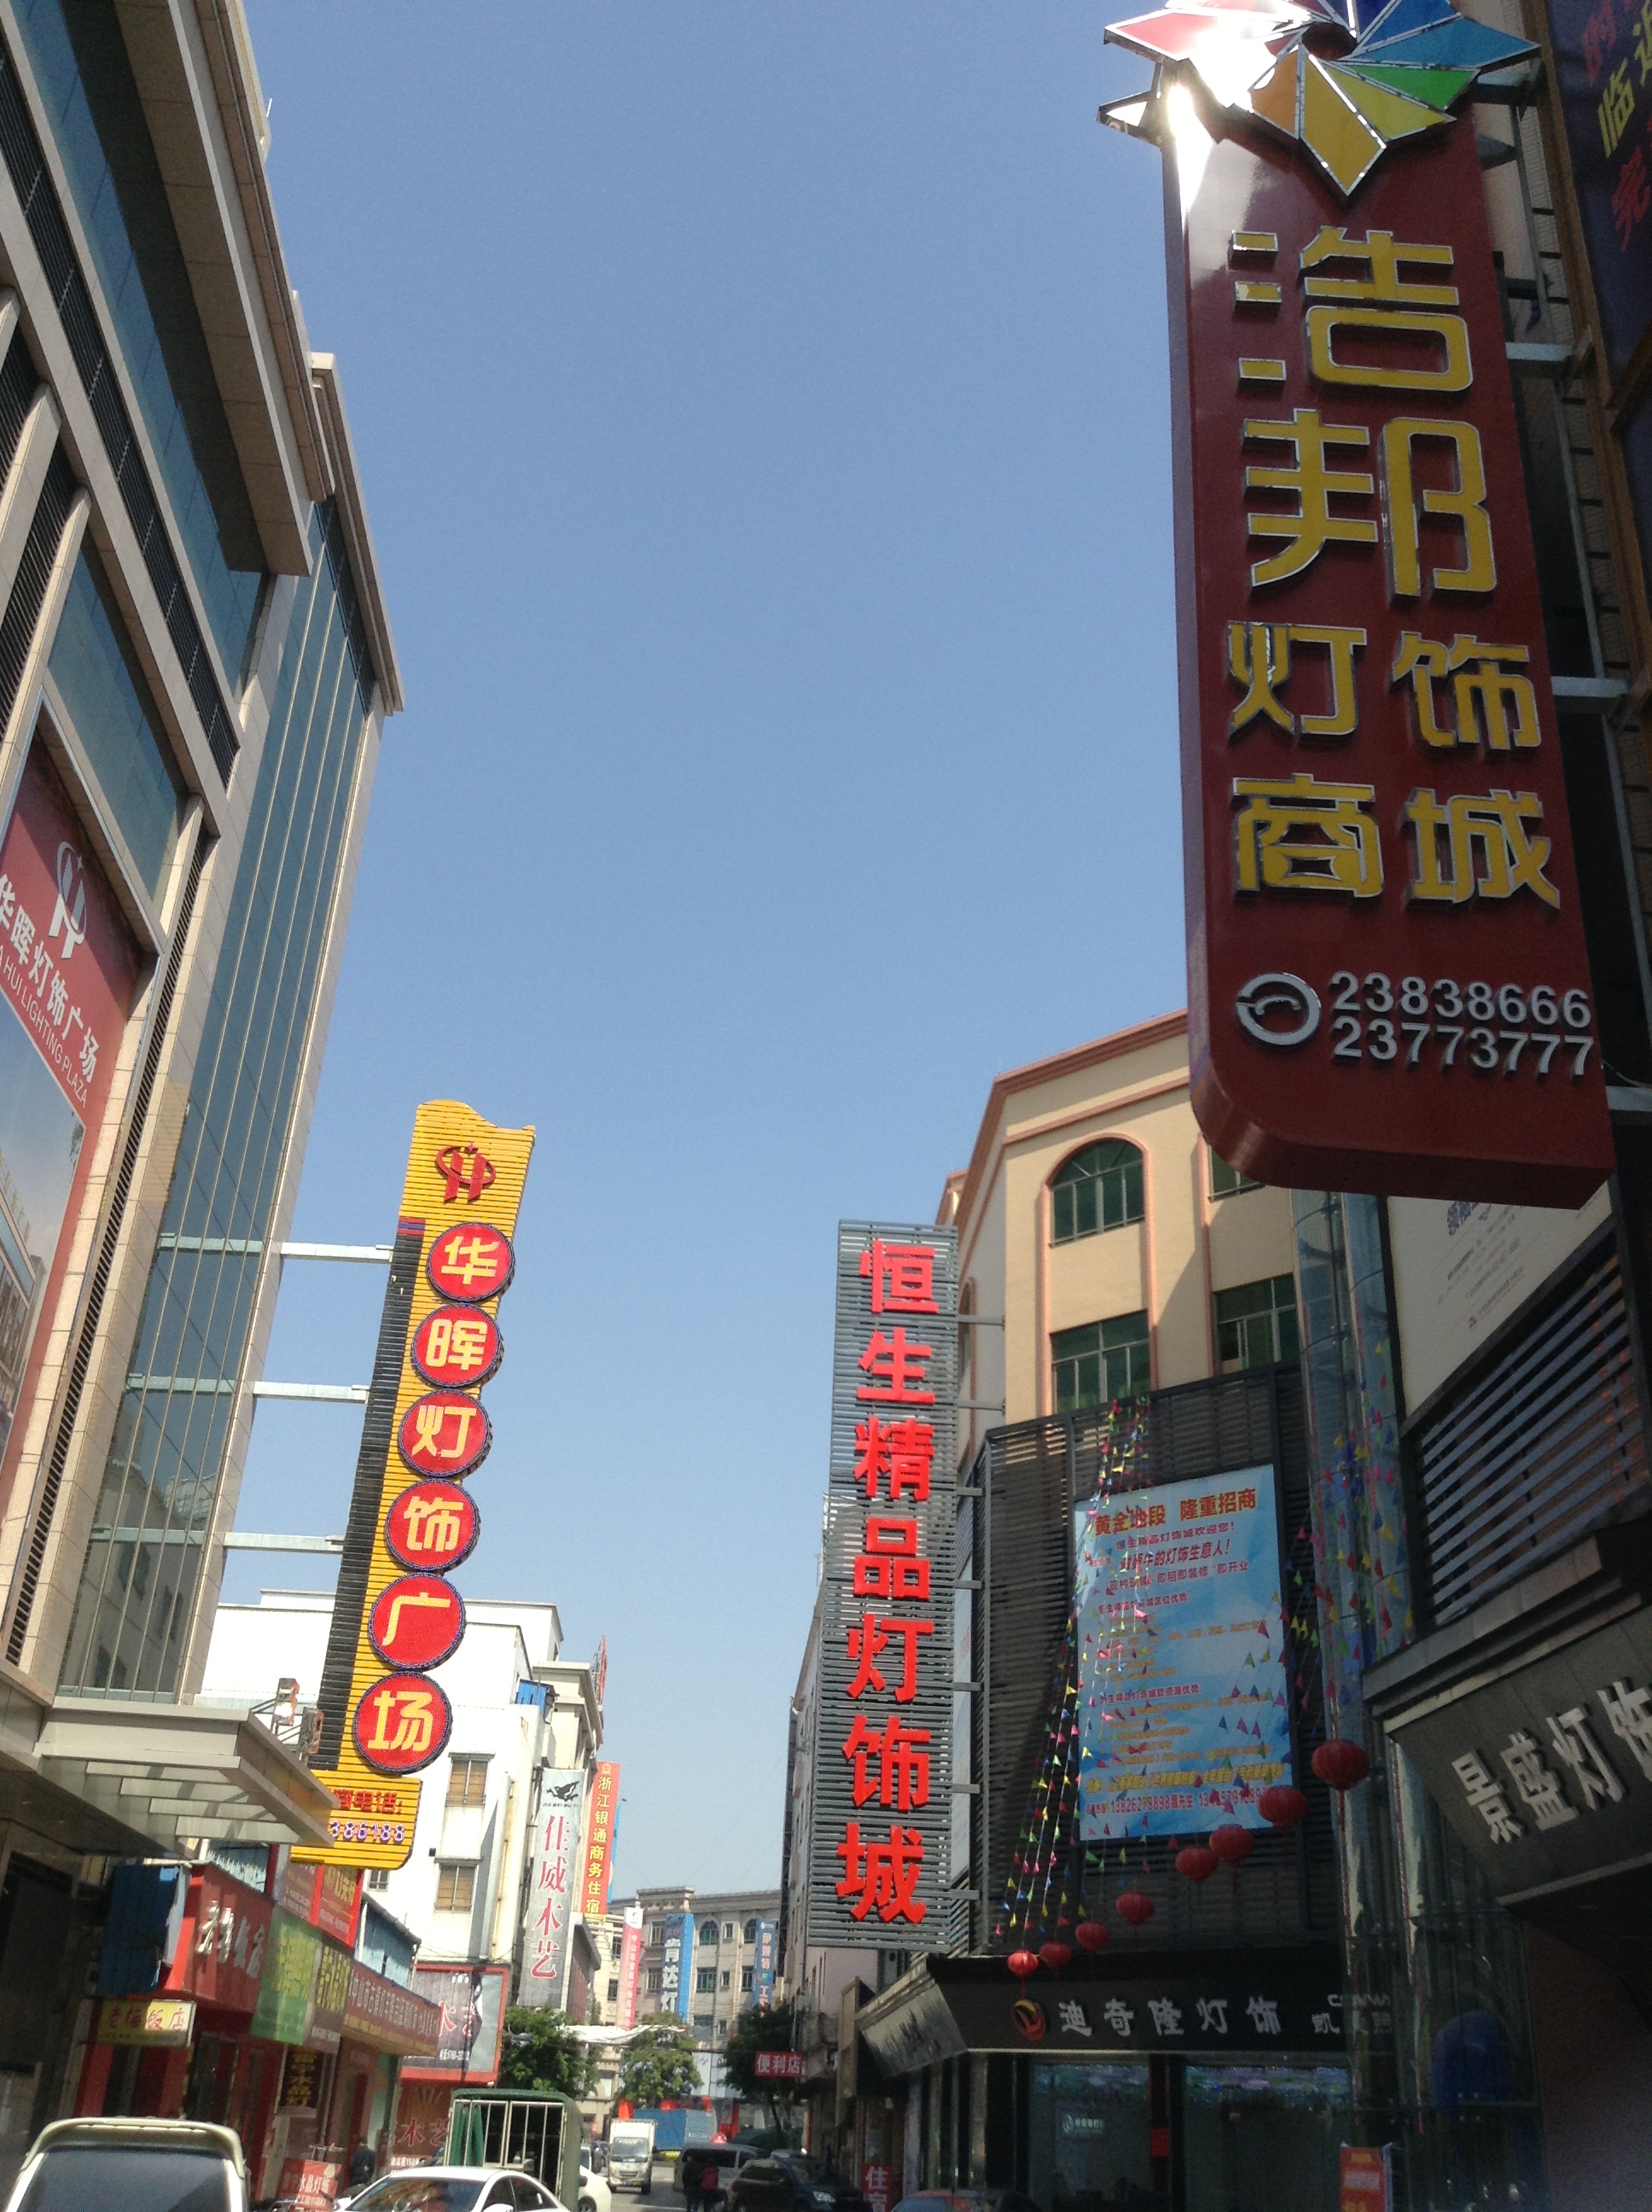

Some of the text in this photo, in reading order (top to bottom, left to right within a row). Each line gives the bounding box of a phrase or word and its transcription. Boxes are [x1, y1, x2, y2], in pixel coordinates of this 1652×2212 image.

[1227, 225, 1498, 597] 浩邦
[1225, 620, 1541, 751] 灯饰
[1230, 771, 1562, 910] 商城
[21, 990, 63, 1065] LIGHTING
[61, 1056, 87, 1109] PLAZA
[1329, 970, 1593, 1030] 23838666
[1329, 1014, 1596, 1080] 23773777
[368, 1235, 500, 1753] 华晖灯饰广场
[1094, 1487, 1257, 1536] 黄金地段 隆重招商
[835, 1237, 939, 1926] 恒生精品灯饰城
[531, 1814, 571, 1979] 佳威木艺
[585, 1776, 613, 1914] 浙江银通商务住宿
[756, 2052, 802, 2075] 便利店
[1057, 1994, 1283, 2038] 迪奇隆灯饰
